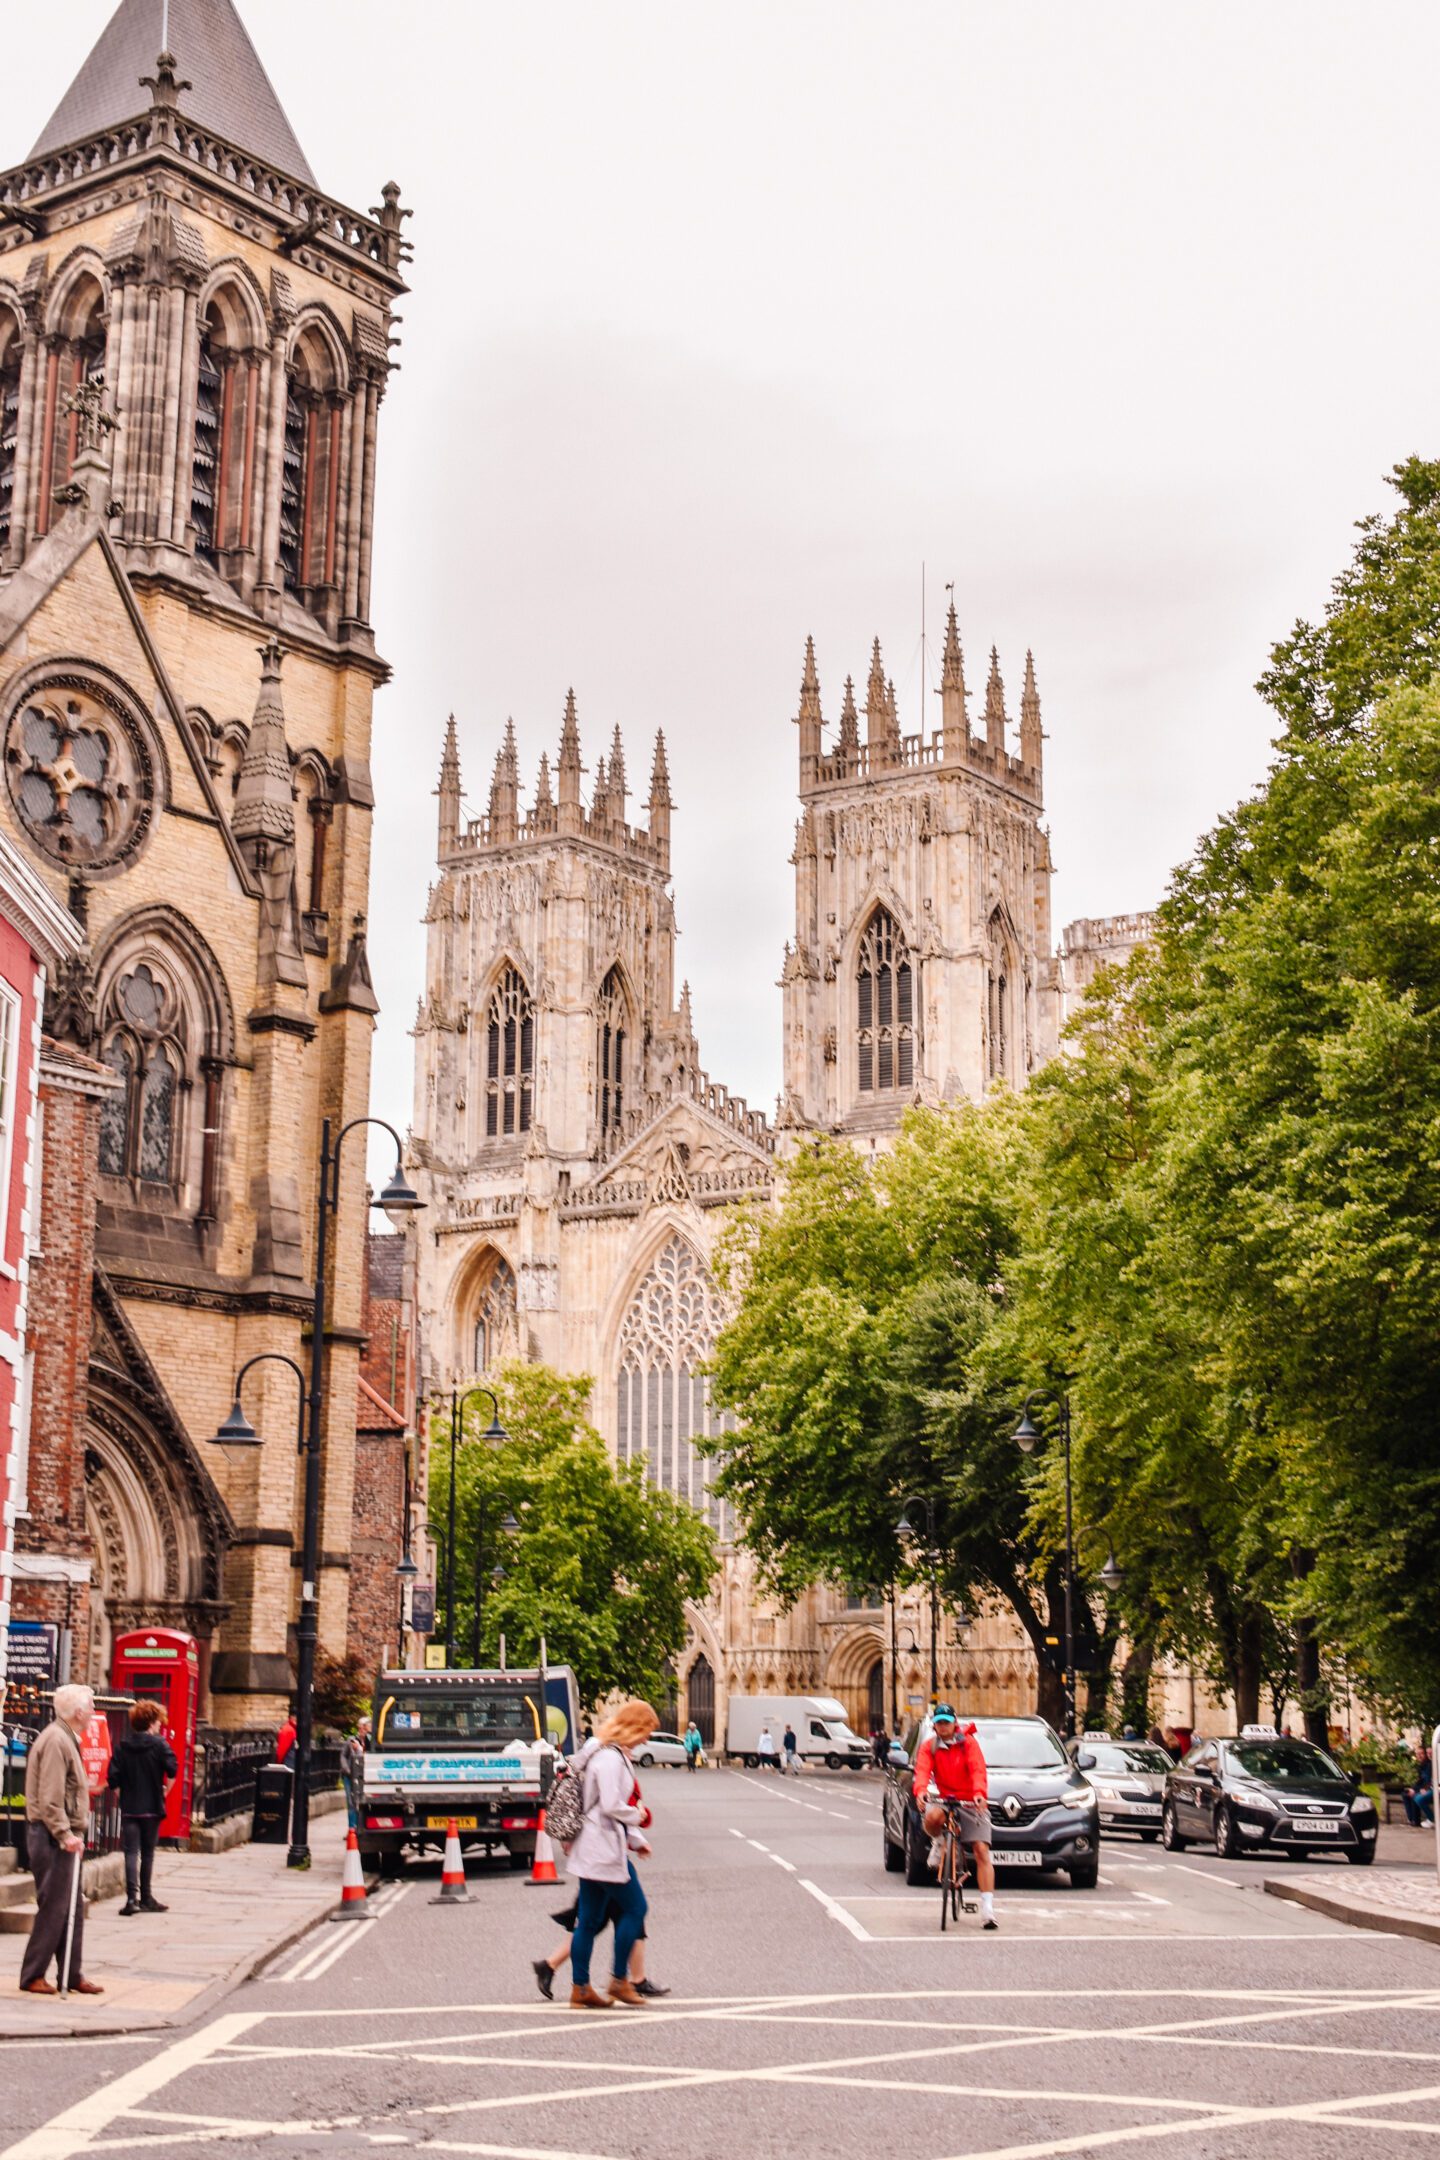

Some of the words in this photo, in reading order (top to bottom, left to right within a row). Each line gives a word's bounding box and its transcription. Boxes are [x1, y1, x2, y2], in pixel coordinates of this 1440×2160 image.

[13, 1635, 24, 1643] ARE
[24, 1635, 49, 1644] CREATIVE
[15, 1645, 26, 1653] ARE
[11, 1655, 21, 1663] ARE
[21, 1656, 51, 1665] AMBITIOUS
[7, 1666, 17, 1674] WE
[17, 1666, 28, 1674] ARE
[429, 1758, 521, 1769] SCAFFOLDING
[993, 1852, 1015, 1863] NN17
[1017, 1852, 1037, 1863] LCA
